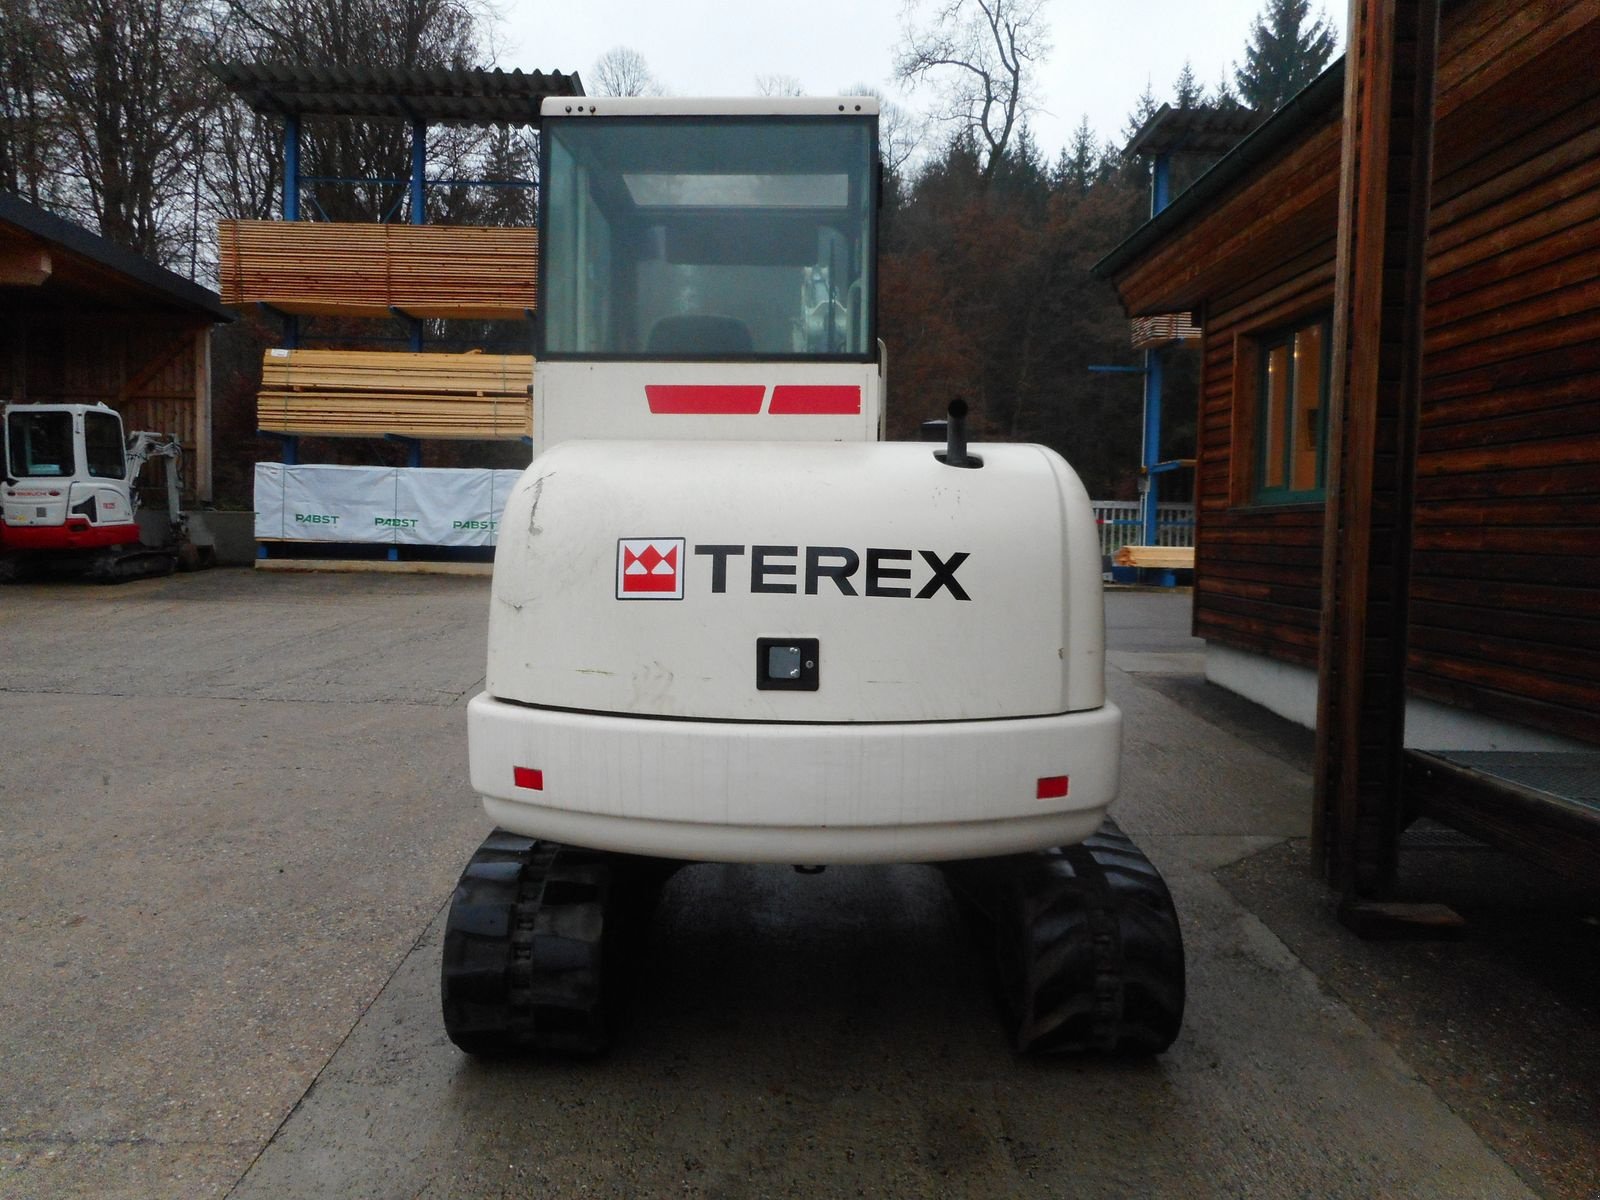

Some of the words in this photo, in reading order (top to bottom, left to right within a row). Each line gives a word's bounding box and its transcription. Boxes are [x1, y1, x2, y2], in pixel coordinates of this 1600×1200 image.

[295, 514, 341, 526] PABST
[374, 517, 418, 528] PABST
[453, 520, 498, 530] PABST
[694, 544, 972, 601] TEREX
